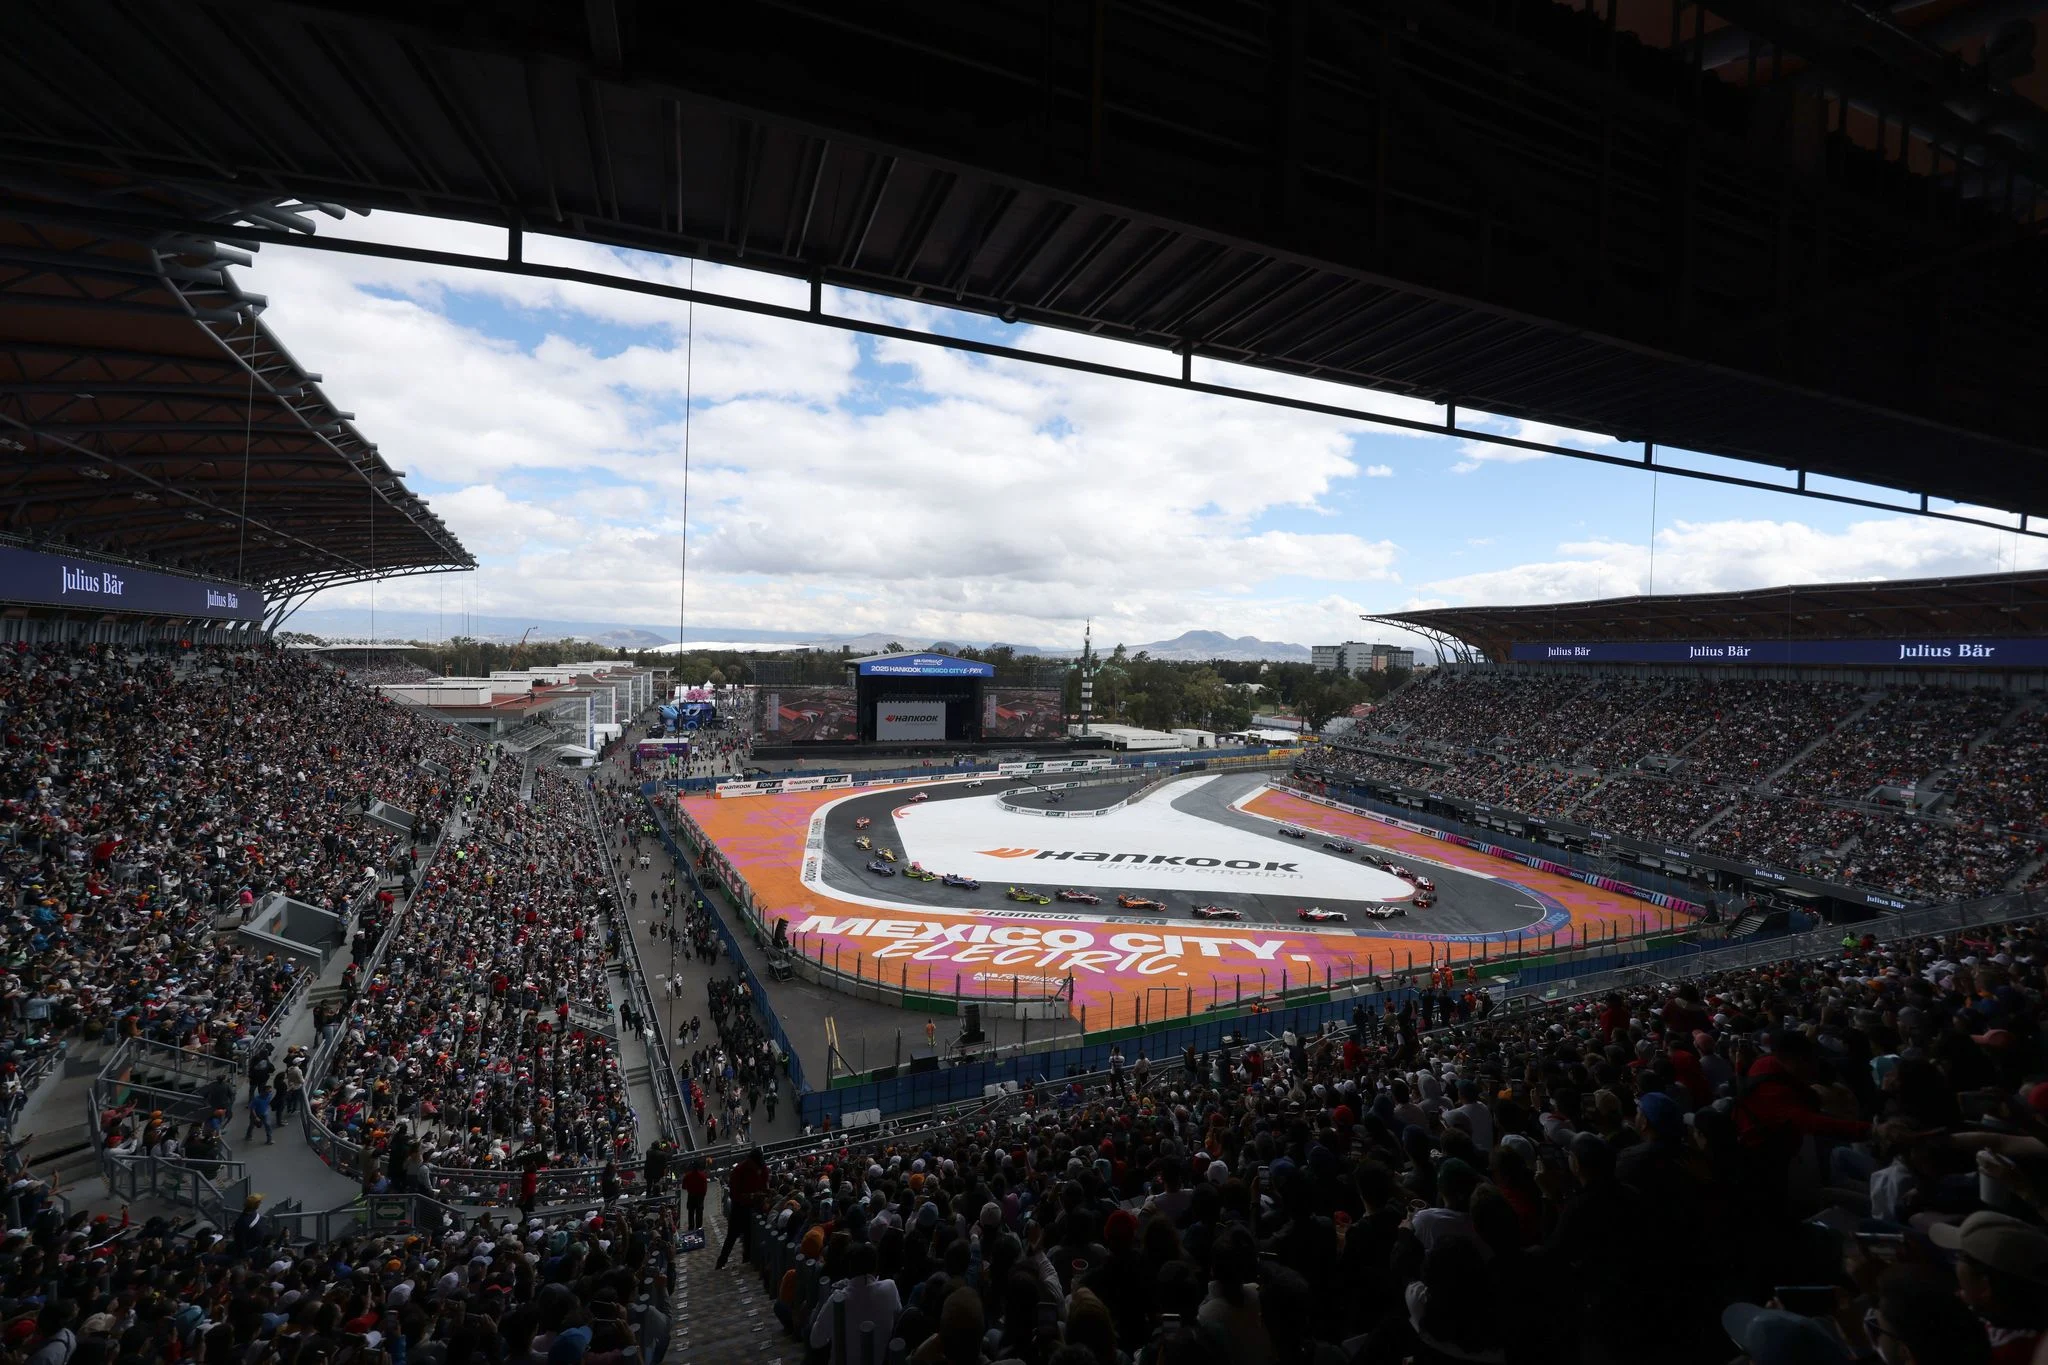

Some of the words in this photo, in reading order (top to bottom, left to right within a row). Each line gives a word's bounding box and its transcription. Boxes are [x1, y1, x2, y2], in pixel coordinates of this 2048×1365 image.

[61, 566, 99, 594] Julius
[103, 573, 124, 595] Bär
[207, 590, 227, 609] Julius
[1547, 647, 1572, 657] Julius
[1574, 647, 1590, 656] Bär
[1689, 646, 1723, 659] Julius
[1727, 645, 1751, 657] Bär
[1899, 644, 1951, 660] Julius
[1957, 644, 1995, 658] Bär
[1665, 847, 1679, 856] Julius
[1033, 850, 1300, 872] HANKOOK
[1098, 862, 1186, 873] driving
[1195, 867, 1304, 879] emotion
[1755, 869, 1772, 879] Julius
[1774, 873, 1786, 881] Bär
[1866, 894, 1889, 906] Julius
[1890, 899, 1906, 910] Bär
[796, 915, 1095, 952] MEXICO
[1109, 932, 1311, 962] CITY.
